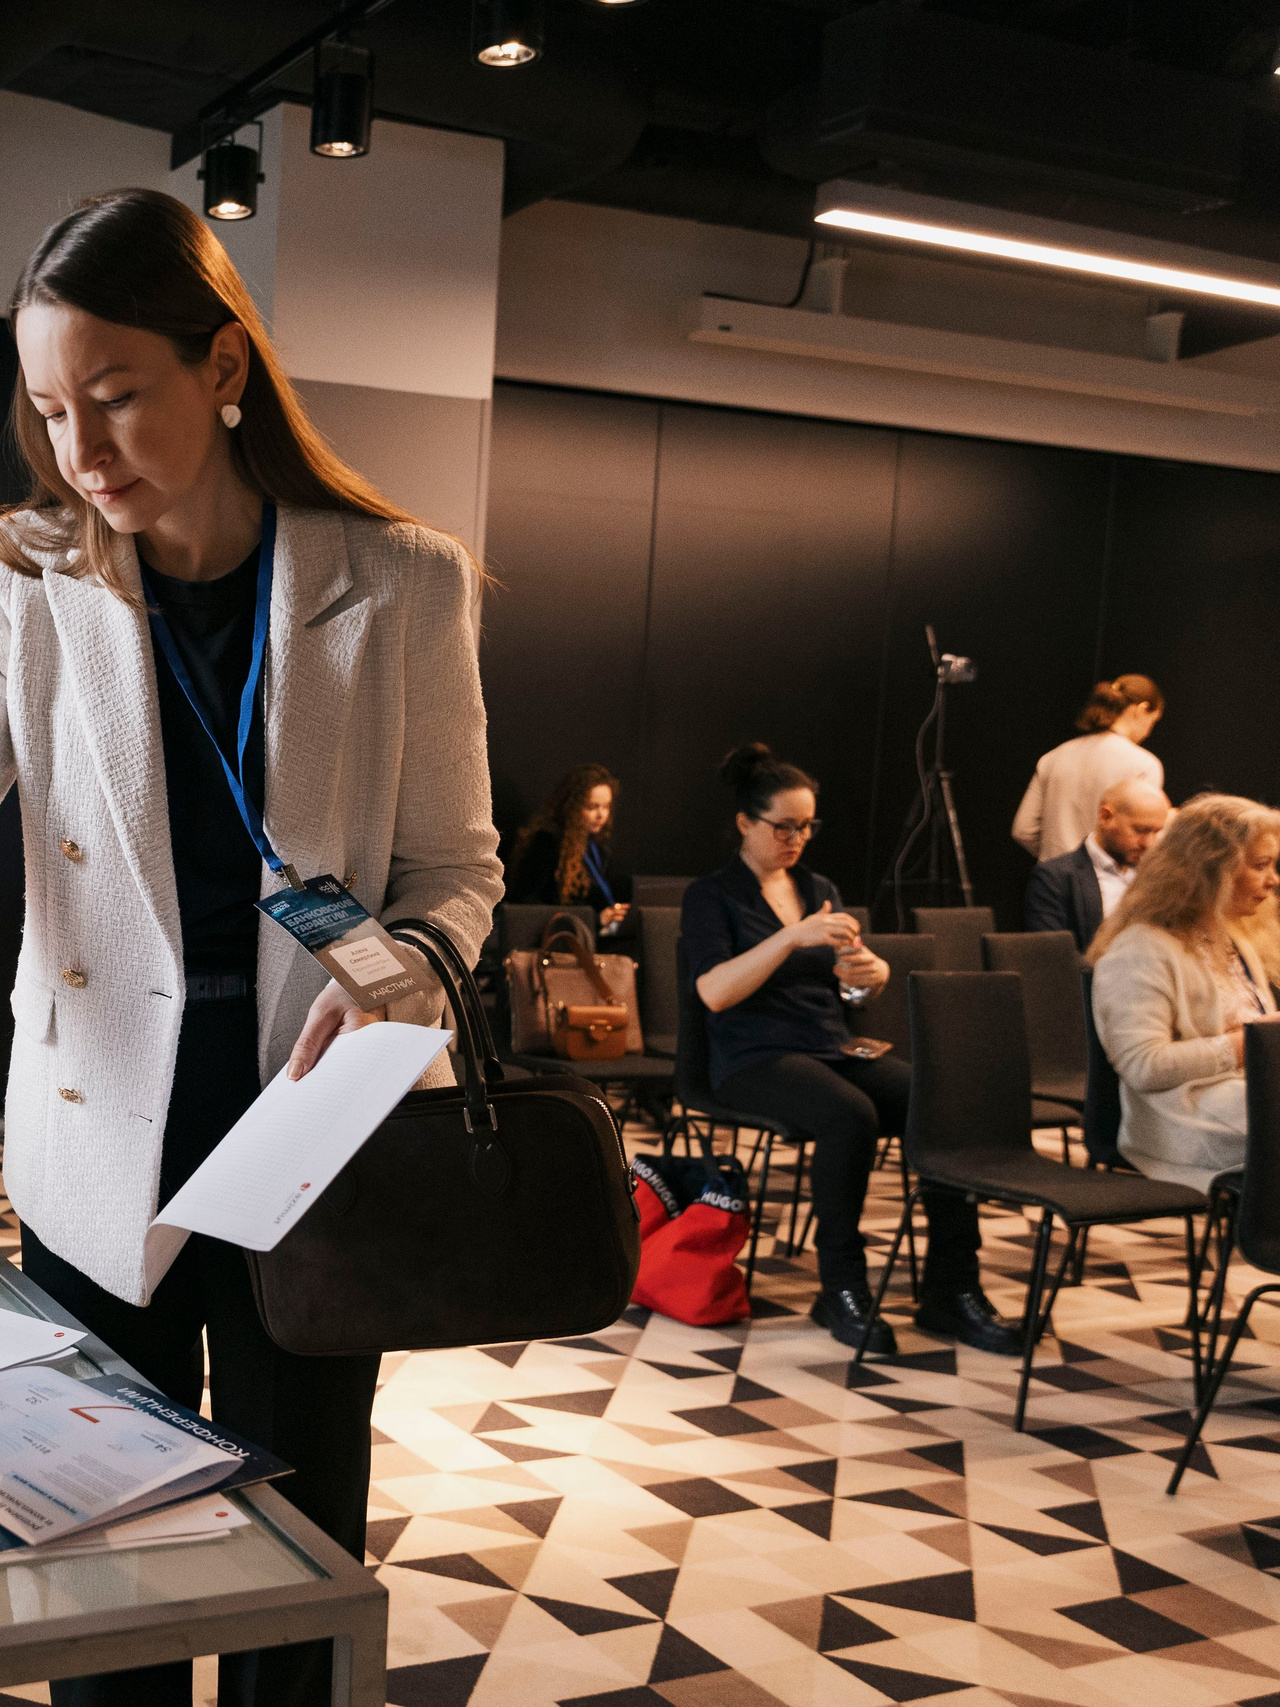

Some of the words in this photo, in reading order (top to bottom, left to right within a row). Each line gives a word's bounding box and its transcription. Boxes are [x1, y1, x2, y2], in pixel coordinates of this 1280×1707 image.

[285, 898, 356, 928] БАНКОВСКИЕ
[293, 910, 349, 934] ГАРАНТИИ
[368, 977, 417, 999] УЧАСТНИК
[631, 1158, 653, 1179] UGO
[700, 1191, 742, 1212] HUGO
[116, 1387, 251, 1459] КОНФЕРЕНЦИИ
